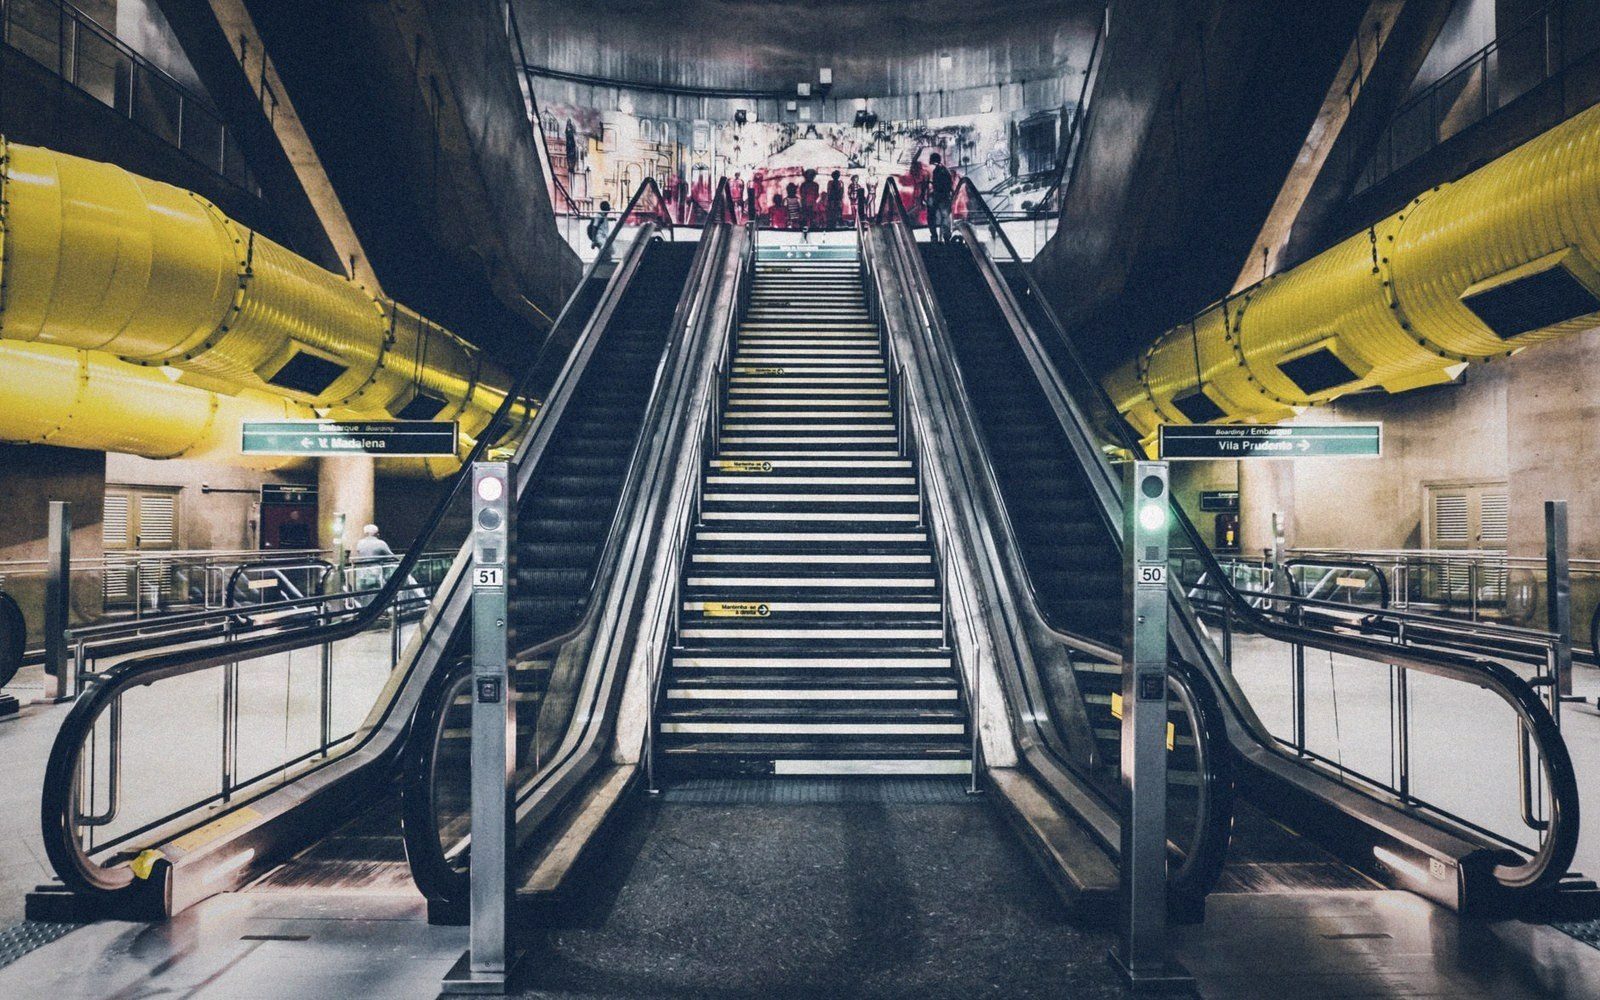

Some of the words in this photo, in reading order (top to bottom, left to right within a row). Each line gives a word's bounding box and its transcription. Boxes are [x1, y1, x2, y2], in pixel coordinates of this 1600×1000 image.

[318, 424, 359, 432] Embarque
[1250, 427, 1292, 435] Embarque
[331, 437, 386, 448] Madalena
[1218, 440, 1239, 450] Vila
[1242, 440, 1293, 450] Prudente
[479, 570, 496, 583] 51
[1142, 568, 1161, 581] 50
